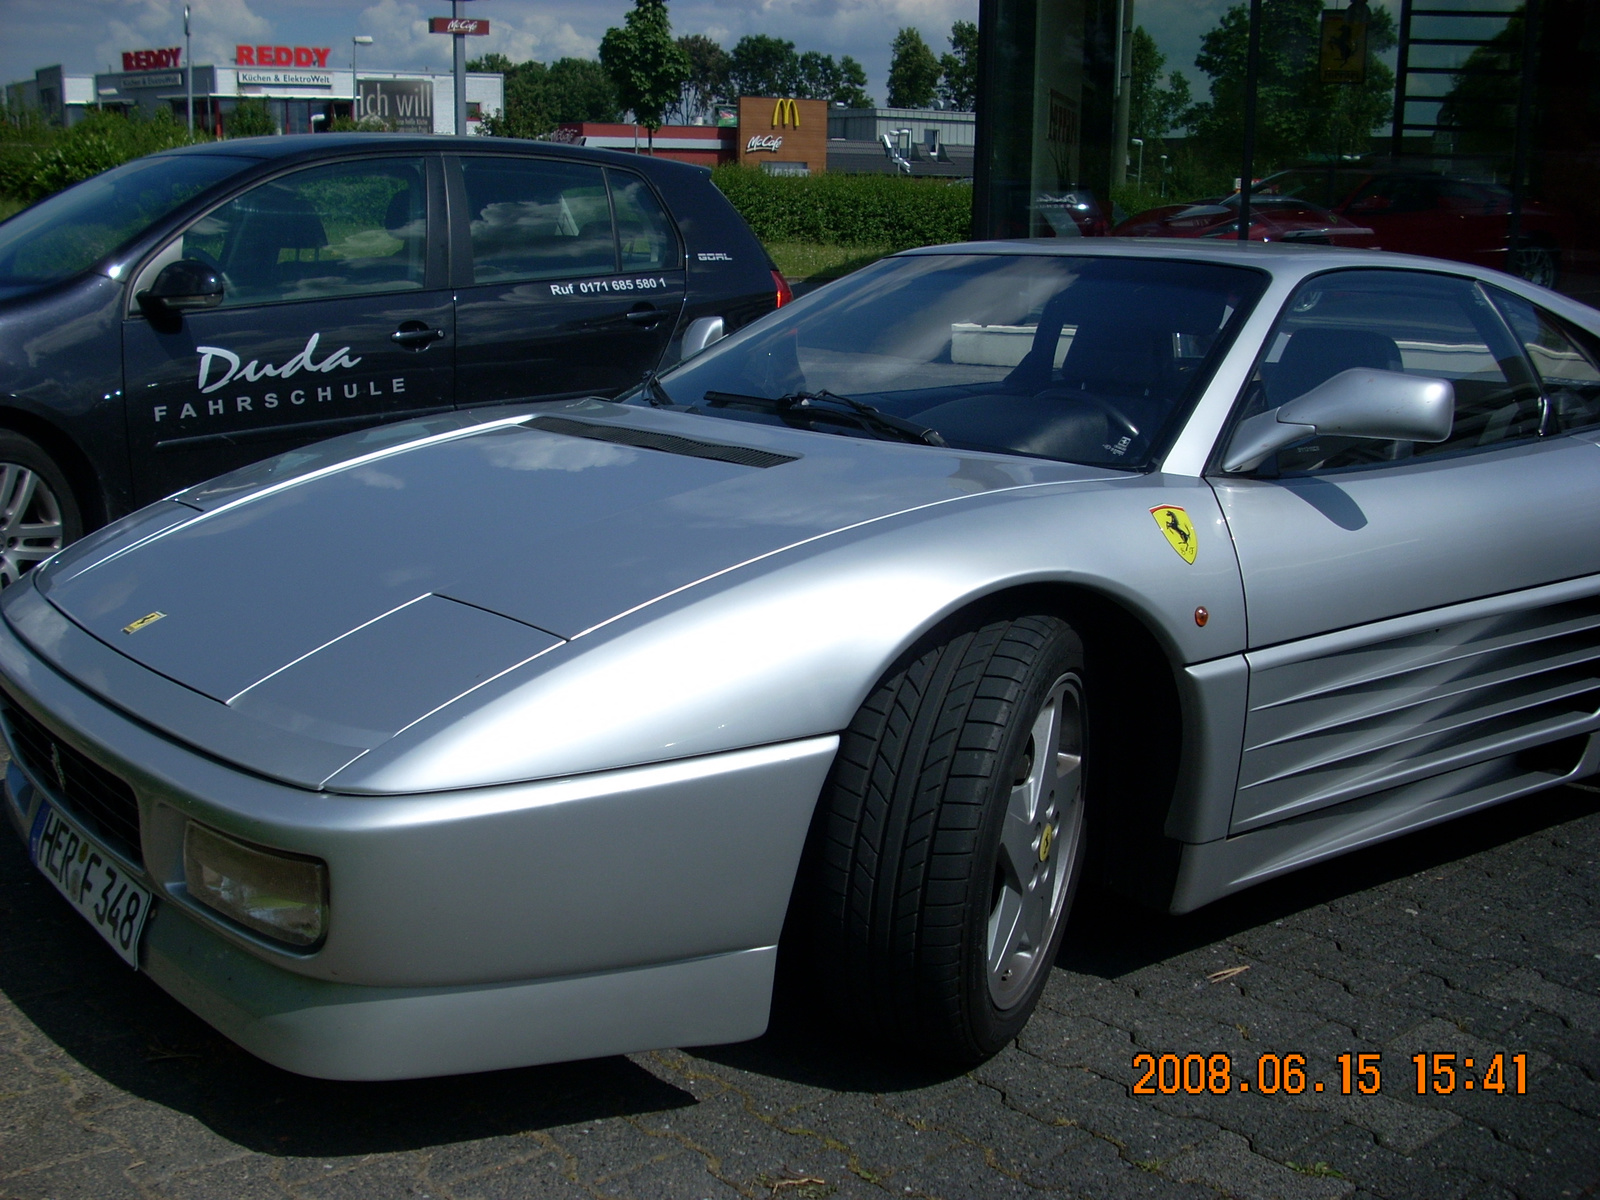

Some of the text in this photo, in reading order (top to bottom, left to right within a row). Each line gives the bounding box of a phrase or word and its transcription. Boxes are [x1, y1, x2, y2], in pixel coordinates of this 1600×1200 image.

[122, 47, 182, 71] REDDY
[236, 45, 331, 68] REDDY
[242, 73, 330, 84] Küchen & ElektroWelt
[360, 83, 431, 117] Ich will
[550, 276, 667, 296] Ruf 0171 685 580 1
[196, 332, 362, 394] Duda
[154, 378, 406, 422] FAHRSCHULE
[40, 812, 80, 890] HER
[94, 866, 140, 950] 348
